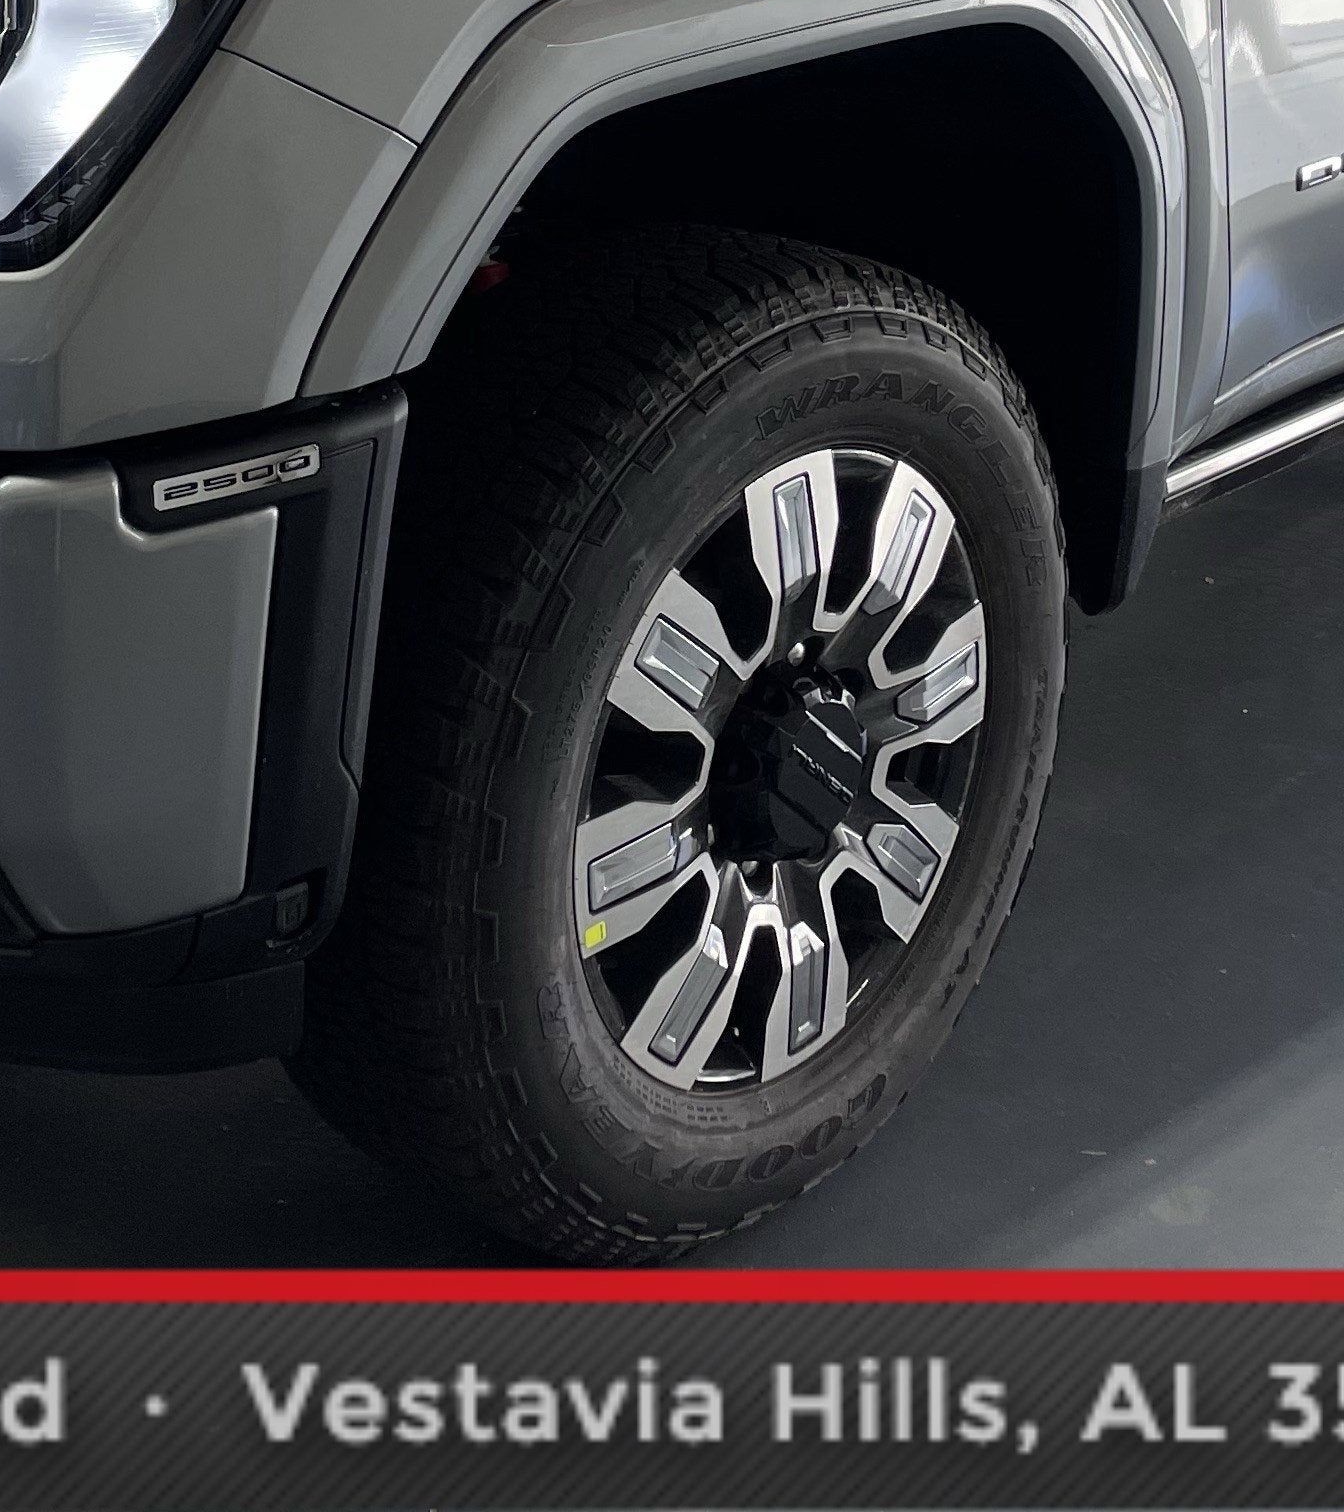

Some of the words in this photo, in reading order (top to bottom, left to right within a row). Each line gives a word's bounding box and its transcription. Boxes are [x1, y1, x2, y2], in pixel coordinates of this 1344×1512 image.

[163, 454, 312, 502] 2500
[756, 368, 1048, 587] WRANGLER
[536, 984, 888, 1190] GOODYEAR
